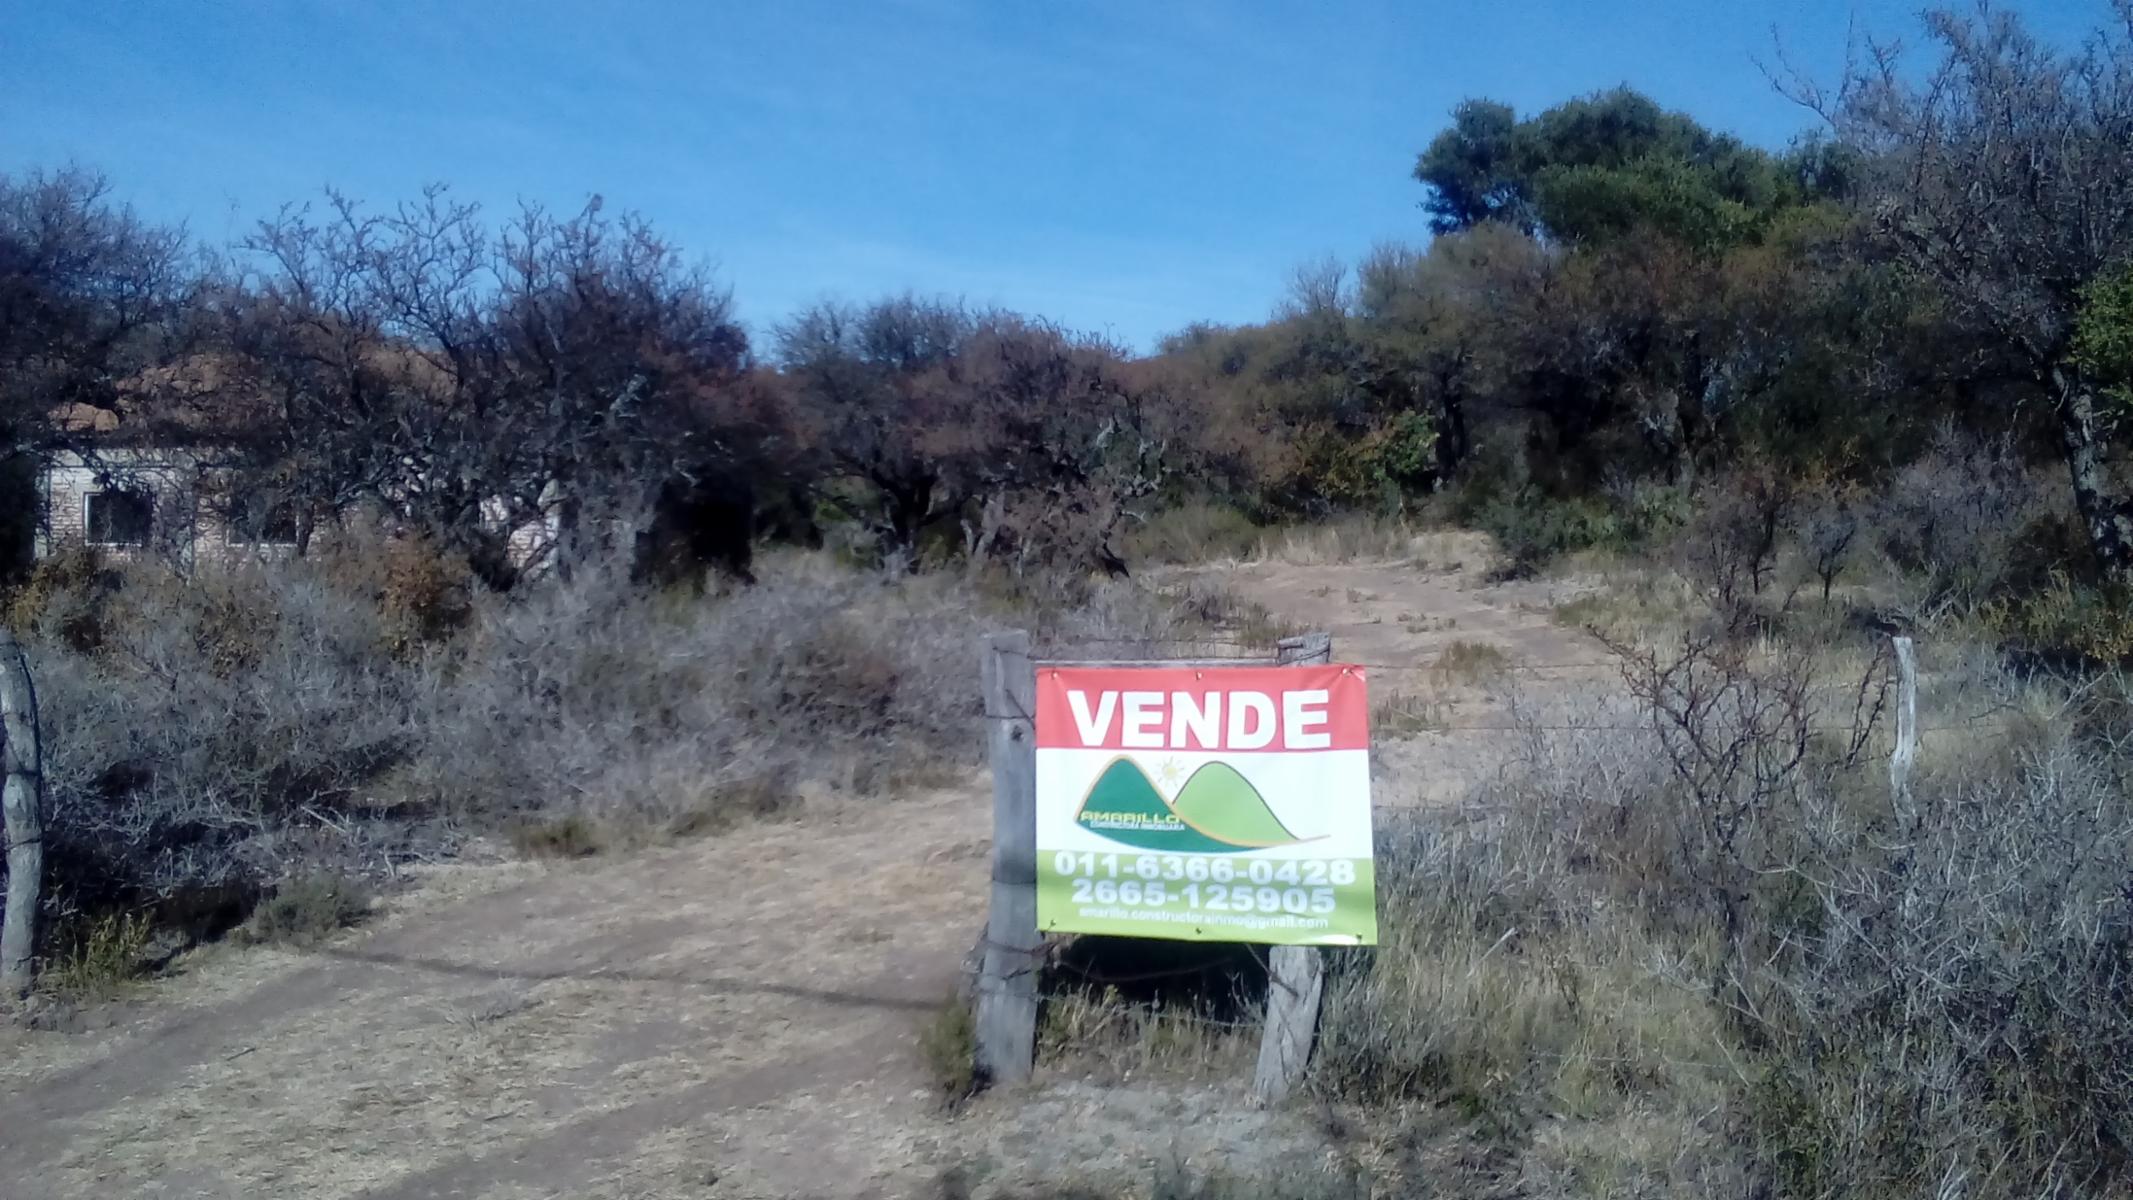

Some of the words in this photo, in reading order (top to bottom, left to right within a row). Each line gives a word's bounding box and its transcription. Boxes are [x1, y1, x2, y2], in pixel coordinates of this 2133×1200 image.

[1066, 689, 1331, 749] VENDE
[1080, 811, 1180, 825] AMARILLO
[1054, 851, 1356, 885] 011-6366-0428
[1071, 880, 1336, 914] 2665-125905
